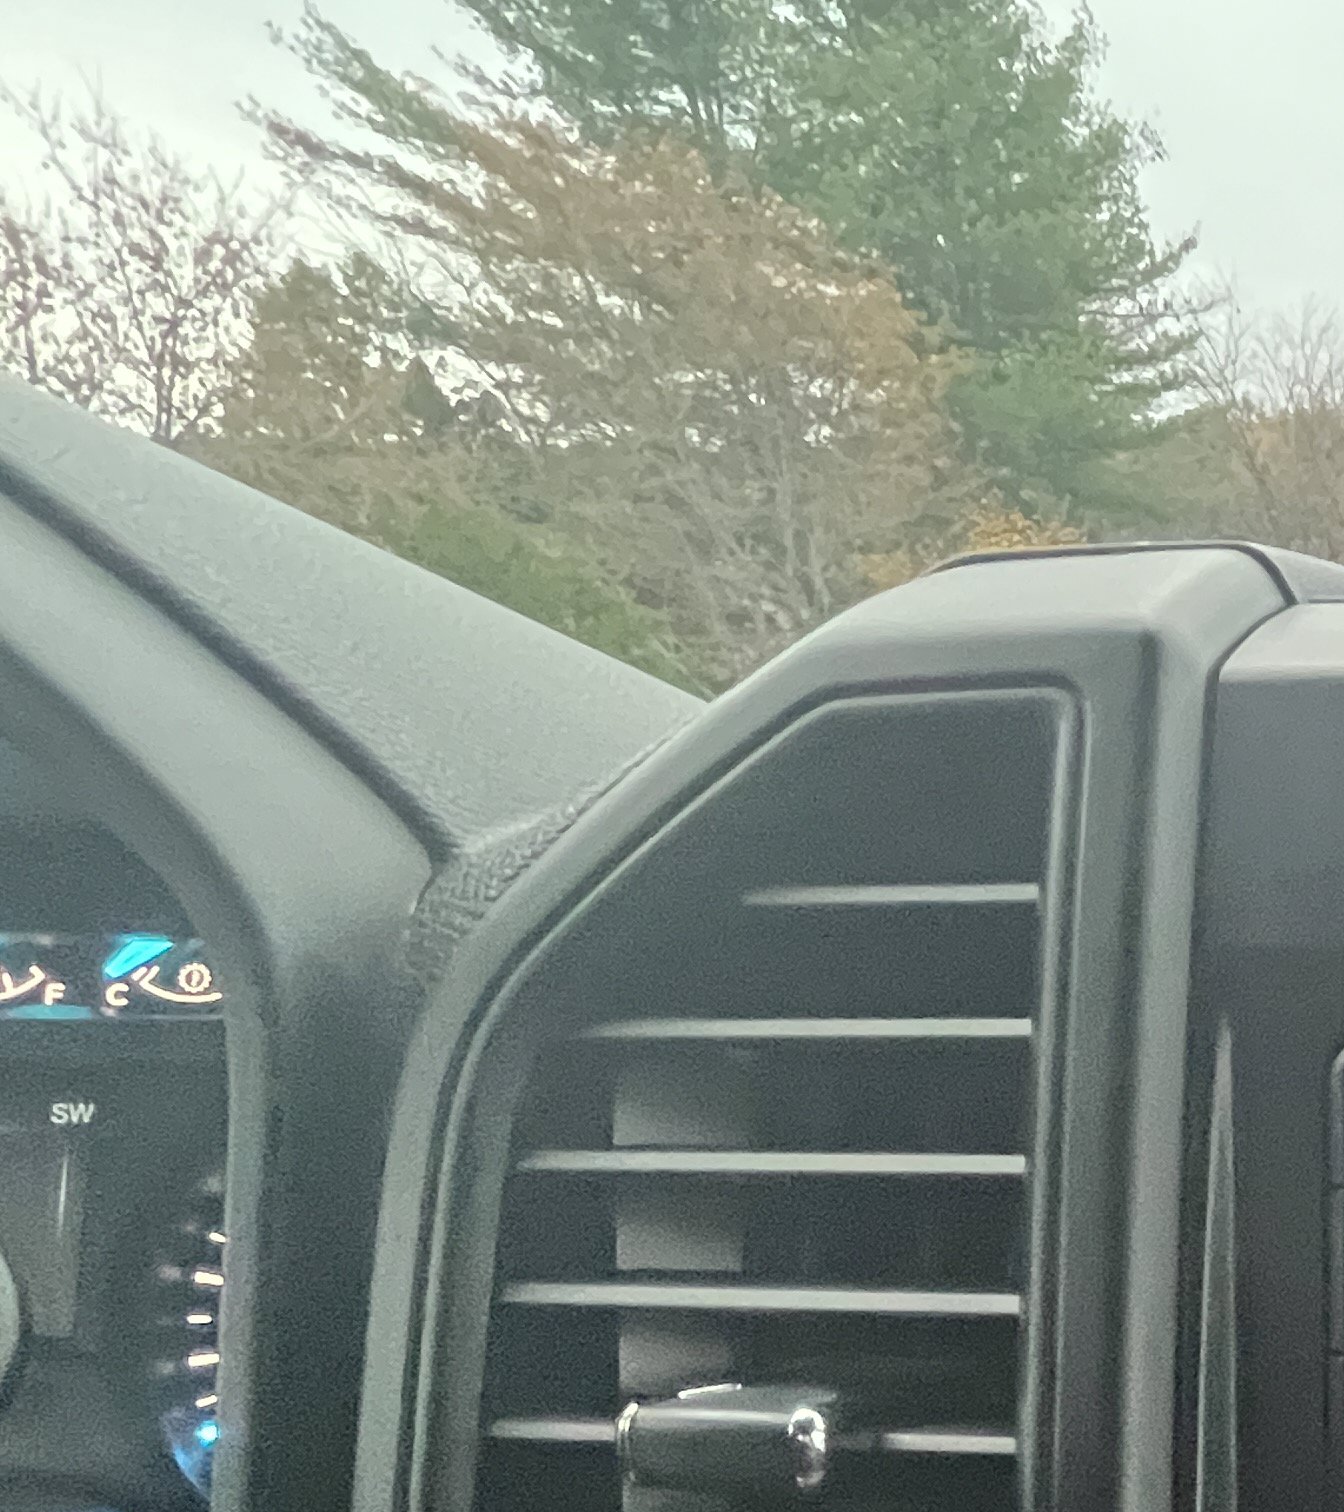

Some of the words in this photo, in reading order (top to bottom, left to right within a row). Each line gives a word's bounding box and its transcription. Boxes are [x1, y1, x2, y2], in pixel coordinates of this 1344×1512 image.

[44, 982, 66, 1006] F
[105, 982, 130, 1007] C
[50, 1102, 95, 1125] SW
